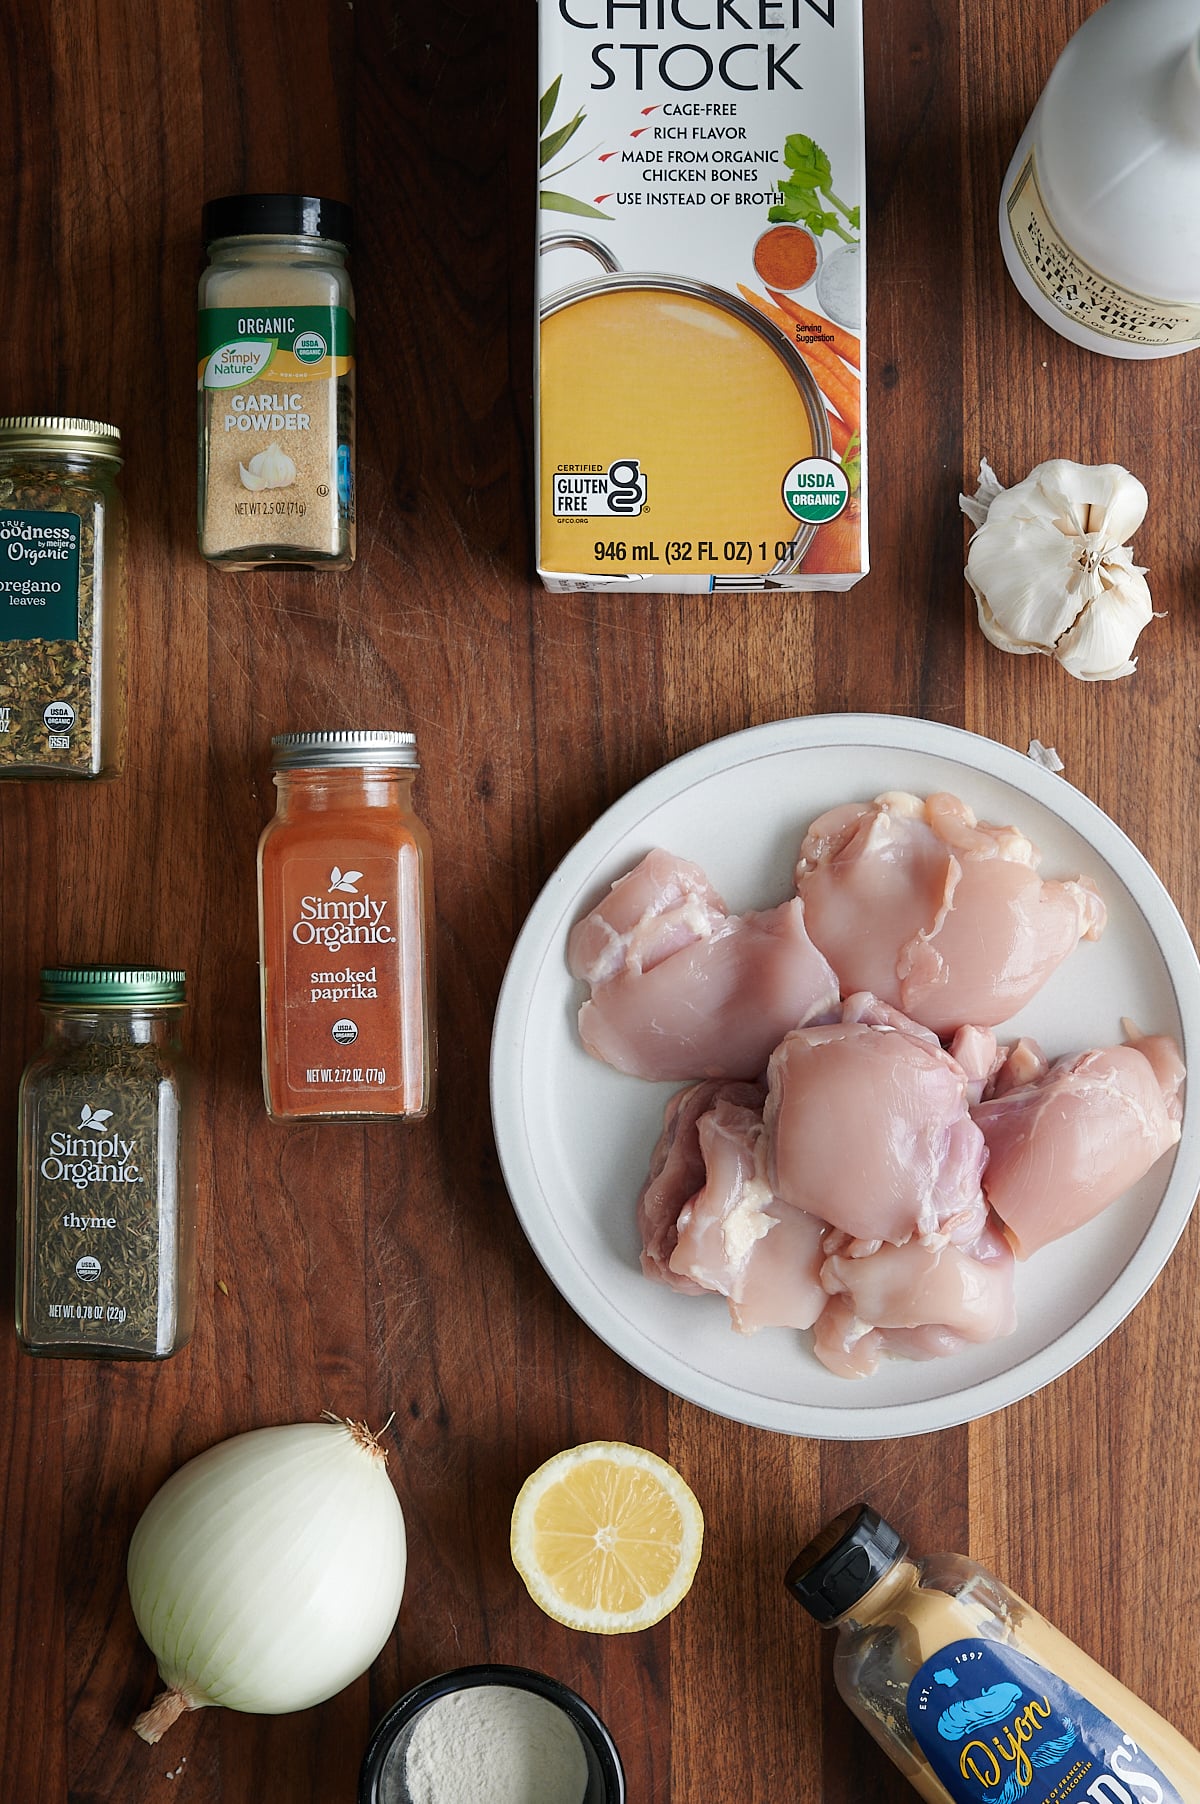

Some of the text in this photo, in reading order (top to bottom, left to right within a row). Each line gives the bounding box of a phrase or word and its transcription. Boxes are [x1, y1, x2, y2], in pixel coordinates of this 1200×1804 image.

[558, 0, 835, 30] CHICKEN
[590, 43, 803, 91] STOCK
[662, 103, 737, 116] CAGE-FREE
[653, 127, 747, 140] RICH FLAVOR
[621, 150, 779, 163] MADE FROM ORGANIC
[642, 169, 758, 182] CHICKEN BONES
[616, 192, 785, 205] USE INSTEAD OF BROTH
[1027, 222, 1079, 296] EXTRA
[1090, 296, 1176, 330] VIRGIN
[1035, 255, 1094, 314] OLIVE
[1100, 314, 1143, 334] OIL
[238, 318, 296, 334] ORGANIC
[795, 324, 822, 333] Serving
[301, 340, 319, 348] USDA
[796, 333, 835, 343] Suggestion
[221, 351, 261, 364] Simply
[231, 394, 303, 412] GARLIC
[224, 413, 312, 433] POWDER
[558, 479, 608, 494] GLUTEN
[797, 473, 835, 488] USDA
[558, 497, 588, 511] FREE
[792, 493, 841, 506] ORGANIC
[234, 502, 307, 517] NET WT 2.5 OZ (71g)
[0, 520, 25, 528] TRUE
[0, 526, 71, 540] oodness
[38, 539, 70, 549] by meijer
[8, 542, 69, 566] Organic
[594, 540, 798, 565] 946 mL (32 FL OZ) 1 QT
[9, 595, 47, 606] leaves
[50, 708, 69, 716] USDA
[300, 895, 388, 927] Simply
[310, 966, 377, 984] smoked
[310, 985, 378, 1003] paprika
[306, 1068, 320, 1083] NET
[334, 1068, 352, 1083] 2.72
[365, 1067, 386, 1084] (77g)
[50, 1132, 137, 1166] Simply
[62, 1212, 117, 1231] thyme
[48, 1304, 62, 1318] NET
[76, 1305, 93, 1319] 0.78
[106, 1306, 127, 1323] (22g)
[919, 1651, 983, 1710] EST. 1897
[959, 1695, 1051, 1789] Dijon
[1060, 1761, 1093, 1800] WISCONSIN
[1050, 1788, 1059, 1799] OF
